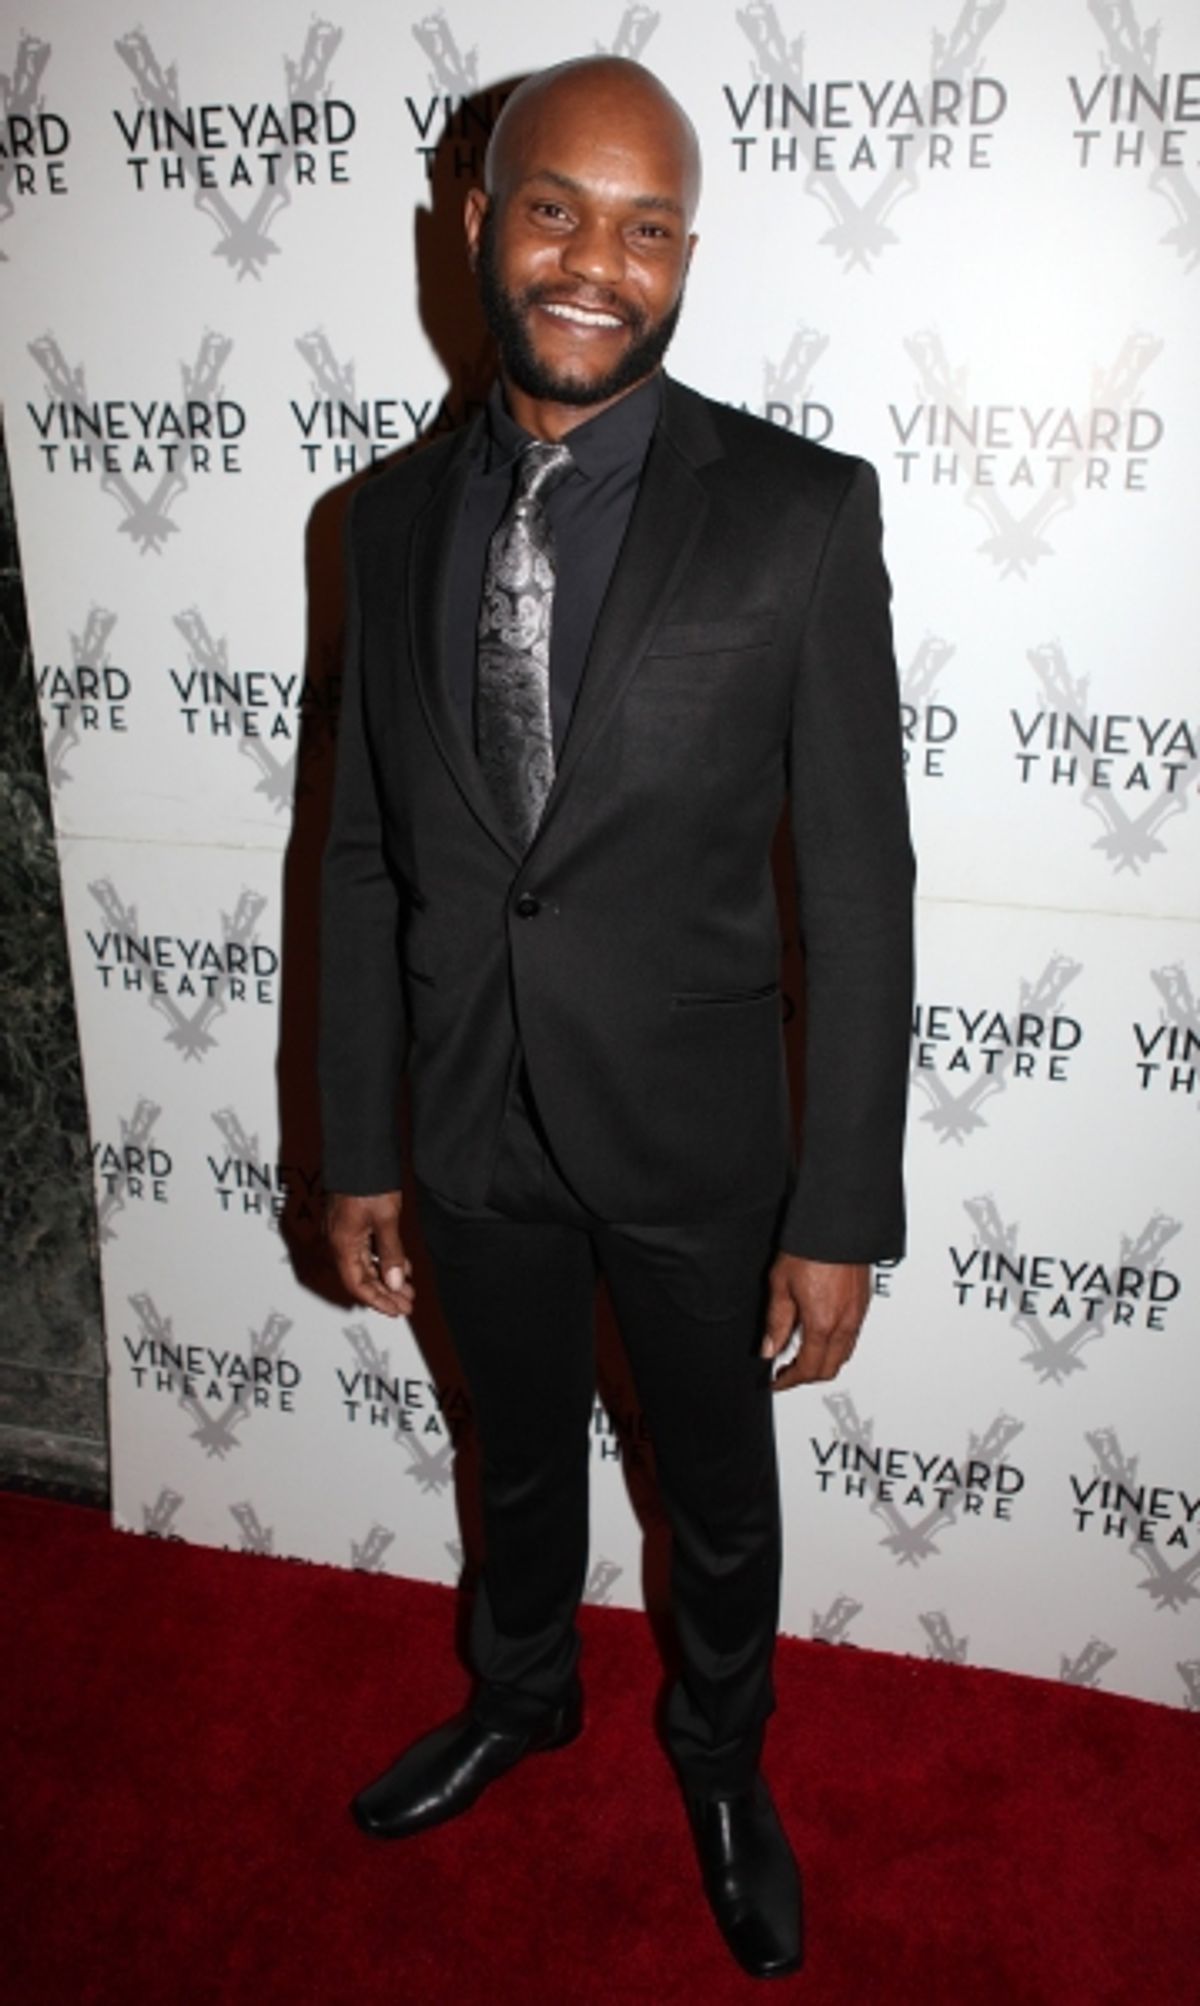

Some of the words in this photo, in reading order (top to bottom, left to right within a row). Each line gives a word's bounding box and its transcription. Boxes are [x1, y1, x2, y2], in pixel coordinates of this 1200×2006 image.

[723, 78, 1008, 131] VINEYARD
[1067, 73, 1200, 123] VINE
[114, 100, 357, 152] VINEYARD
[127, 151, 351, 191] THEATRE
[731, 134, 993, 172] THEATRE
[27, 400, 247, 440] VINEYARD
[888, 404, 1164, 452] VINEYARD
[39, 444, 242, 474] THEATRE
[894, 451, 1149, 491] THEATRE
[1010, 708, 1197, 760] VINEYA
[1015, 753, 1188, 793] THEAT
[85, 930, 279, 977] VINEYARD
[96, 965, 274, 1004] THEATRE
[918, 1043, 1070, 1081] EATRE
[949, 1246, 1181, 1303] VINEYARD
[952, 1282, 1167, 1331] THEATRE
[124, 1336, 301, 1388] VINEYARD
[131, 1366, 296, 1412] THEATRE
[811, 1438, 1025, 1495] VINEYARD
[814, 1471, 1012, 1521] THEATRE
[1070, 1474, 1200, 1523] VINEY
[1072, 1507, 1189, 1549] THEA
